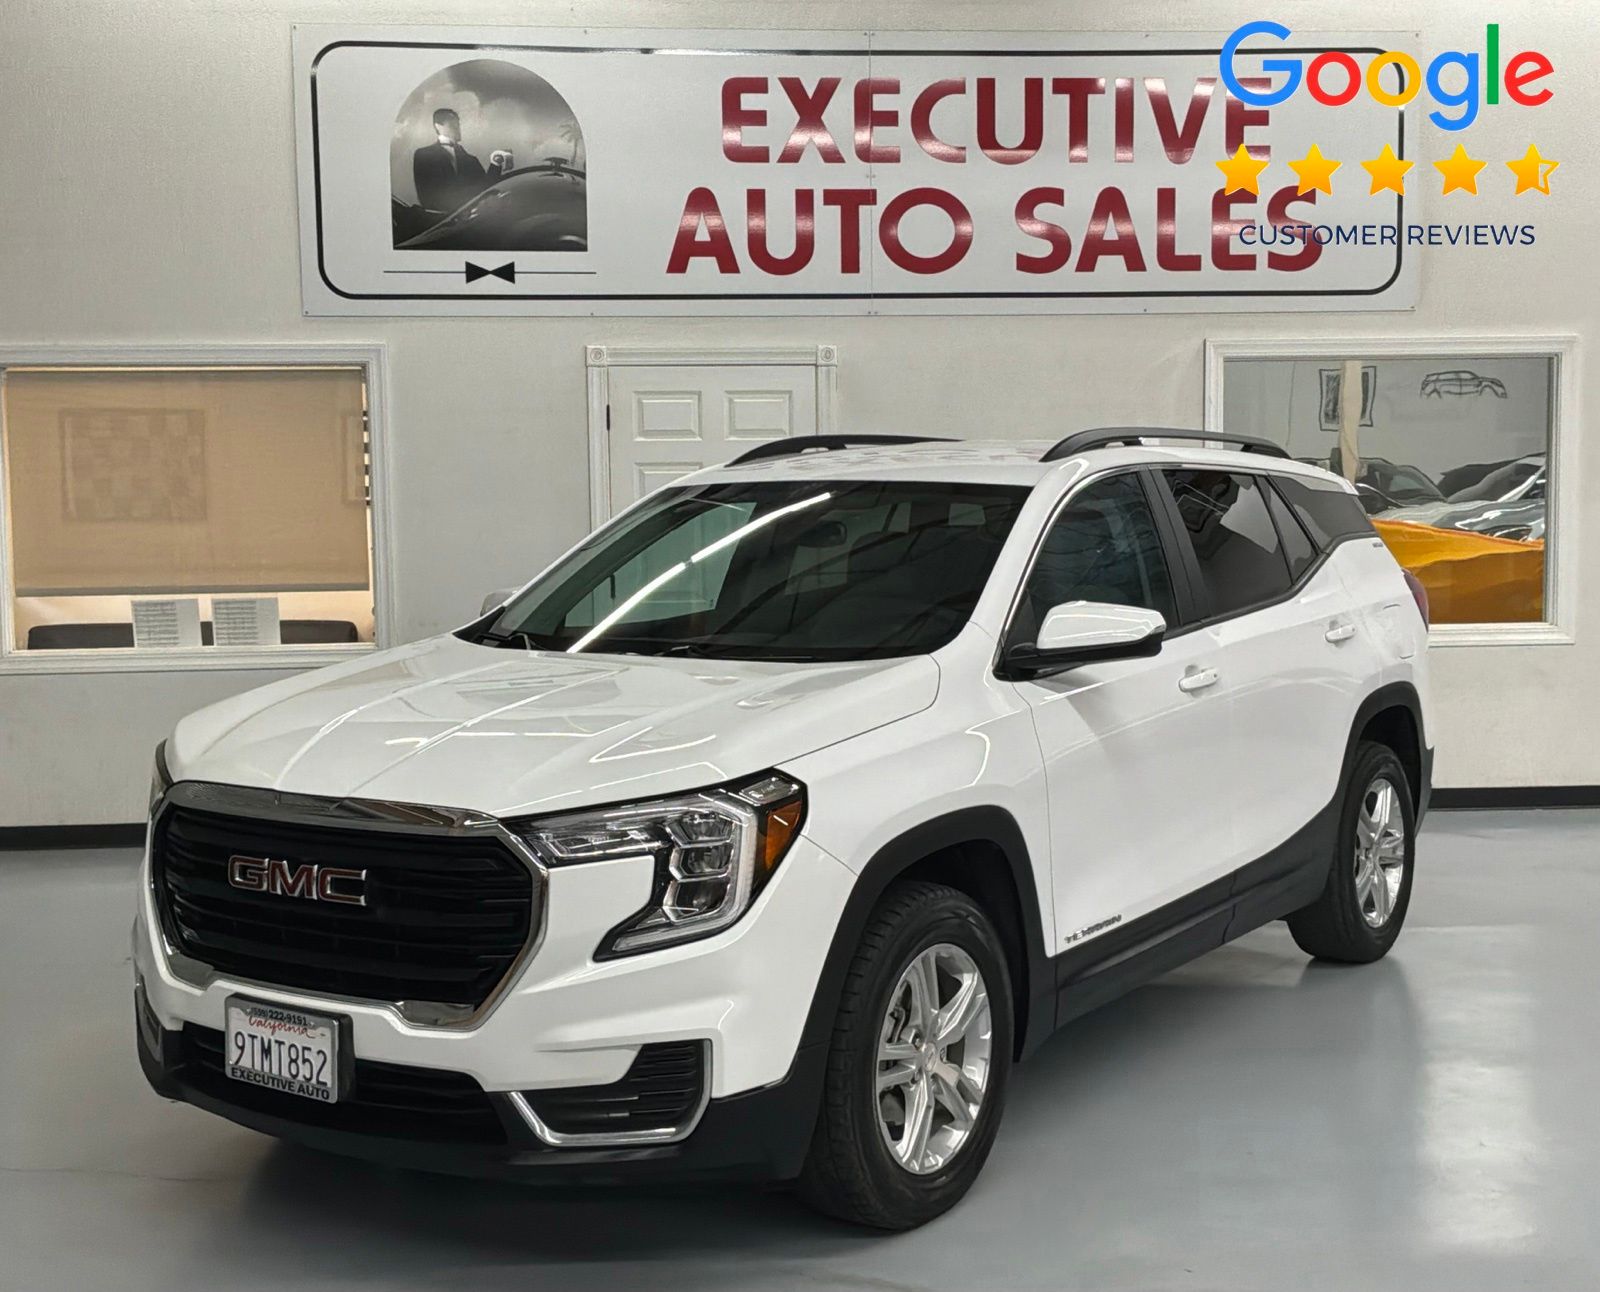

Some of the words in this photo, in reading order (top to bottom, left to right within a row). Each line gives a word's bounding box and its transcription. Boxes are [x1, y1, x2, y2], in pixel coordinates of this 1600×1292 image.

[721, 76, 1272, 165] EXECUTIVE
[665, 186, 974, 276] AUTO
[1014, 185, 1324, 275] SALES
[228, 854, 367, 906] GMC
[231, 1067, 295, 1093] EXECUTIVE
[297, 1084, 331, 1100] AUTO
[234, 1031, 328, 1087] 9TMT852
